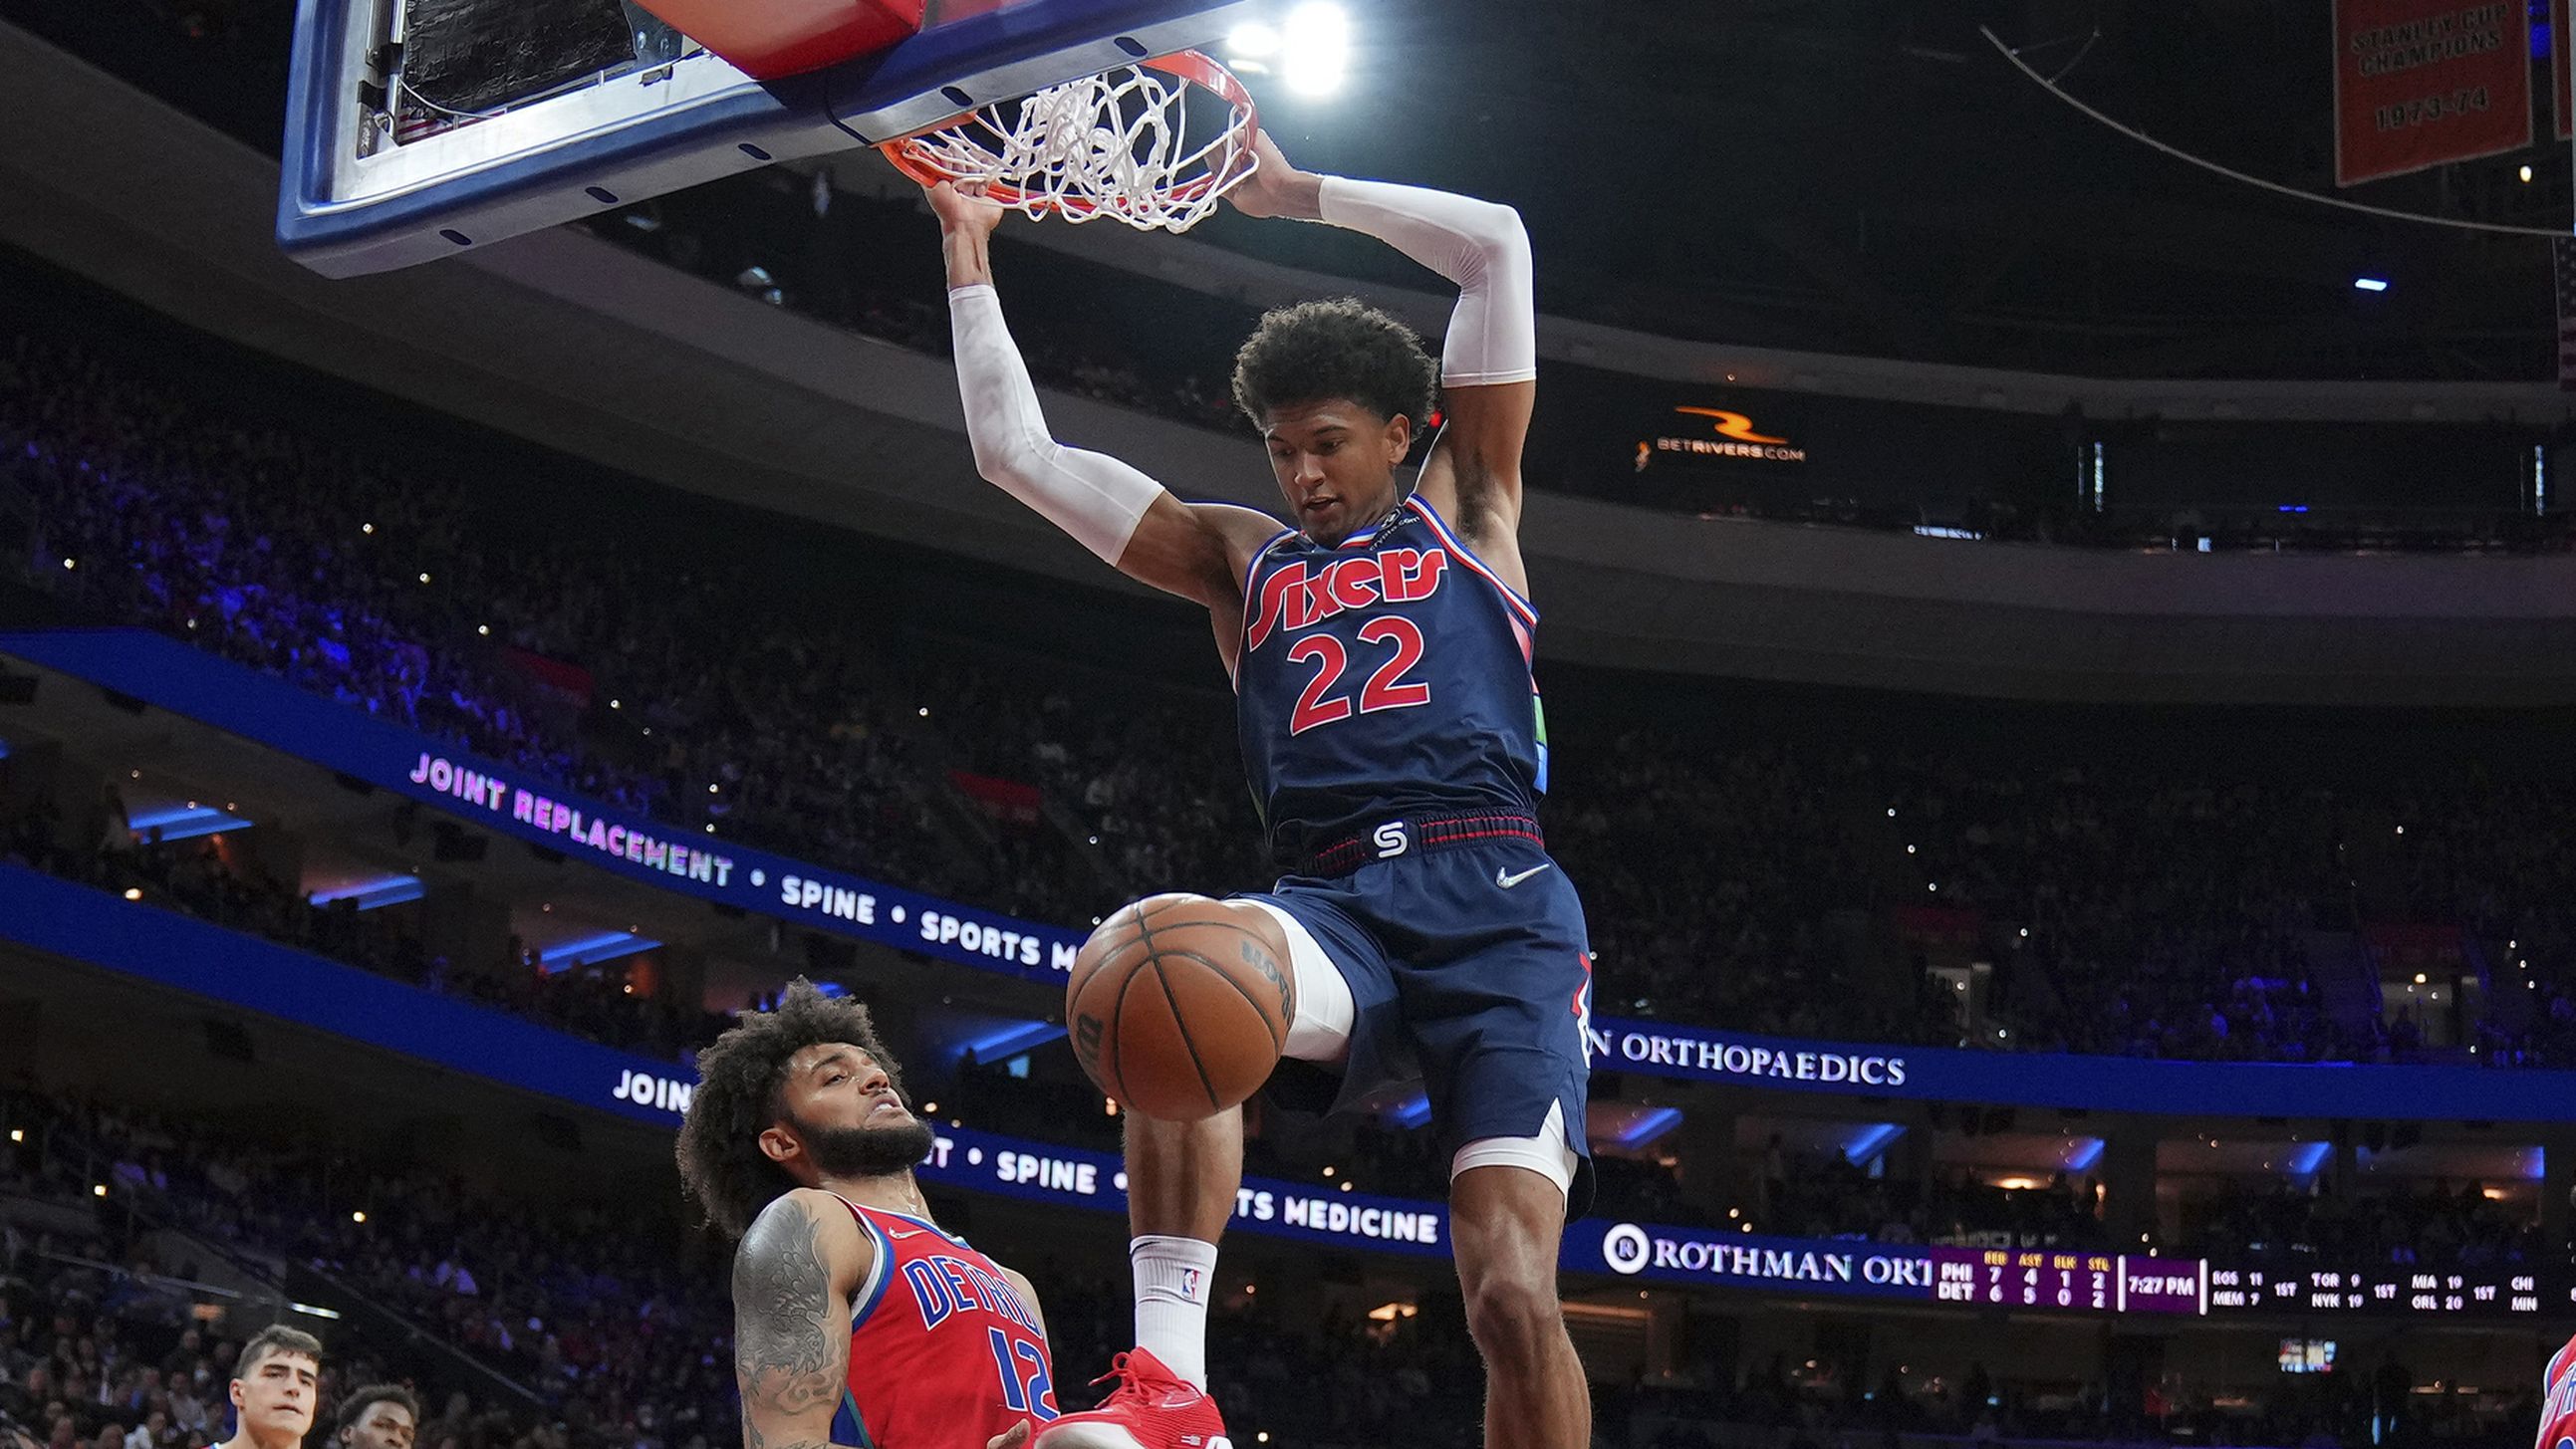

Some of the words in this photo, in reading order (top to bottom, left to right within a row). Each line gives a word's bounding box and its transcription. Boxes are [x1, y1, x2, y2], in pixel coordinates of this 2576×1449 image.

[2352, 16, 2451, 54] STANLEY
[2459, 4, 2508, 30] CUP
[2359, 28, 2500, 78] CHAMPIONS
[2375, 86, 2488, 131] 1973-74
[1247, 547, 1448, 652] Sixers
[1286, 614, 1430, 737] 22
[409, 751, 506, 813] JOINT
[513, 787, 733, 886] REPLACEMENT
[781, 874, 877, 925] SPINE
[919, 910, 1042, 966] SPORTS
[1621, 1033, 1907, 1087] ORTHOPAEDICS
[612, 1069, 691, 1114] JOIN
[996, 1150, 1097, 1195] SPINE
[1284, 1195, 1438, 1244] MEDICINE
[1654, 1238, 1854, 1283] ROTHMAN
[2018, 1253, 2042, 1268] AST
[1940, 1262, 1973, 1283] PHI
[1988, 1266, 2002, 1284] 7
[2023, 1268, 2038, 1287] 4
[2060, 1270, 2071, 1288] 1
[2092, 1272, 2105, 1290] 2
[2128, 1275, 2165, 1295] 7:27
[2166, 1277, 2195, 1297] PM
[2249, 1271, 2263, 1287] 11
[2274, 1282, 2297, 1298] 1ST
[2311, 1272, 2340, 1288] TOR
[2351, 1273, 2361, 1288] 9
[2412, 1274, 2439, 1290] MIA
[2447, 1275, 2463, 1290] 19
[2511, 1276, 2534, 1292] CHI
[901, 1255, 1043, 1339] DETRO
[1937, 1281, 1976, 1302] DET
[1989, 1284, 2003, 1303] 6
[2023, 1286, 2037, 1305] 5
[2057, 1288, 2072, 1307] 0
[2092, 1290, 2106, 1309] 2
[2212, 1291, 2245, 1307] MEM
[2250, 1292, 2260, 1307] 7
[2311, 1294, 2341, 1309] NYK
[2348, 1294, 2364, 1309] 19
[2374, 1284, 2397, 1300] 1ST
[2412, 1296, 2439, 1311] ORL
[2446, 1296, 2463, 1311] 20
[2473, 1286, 2497, 1301] 1ST
[2511, 1297, 2538, 1312] MIN
[987, 1326, 1062, 1423] 12
